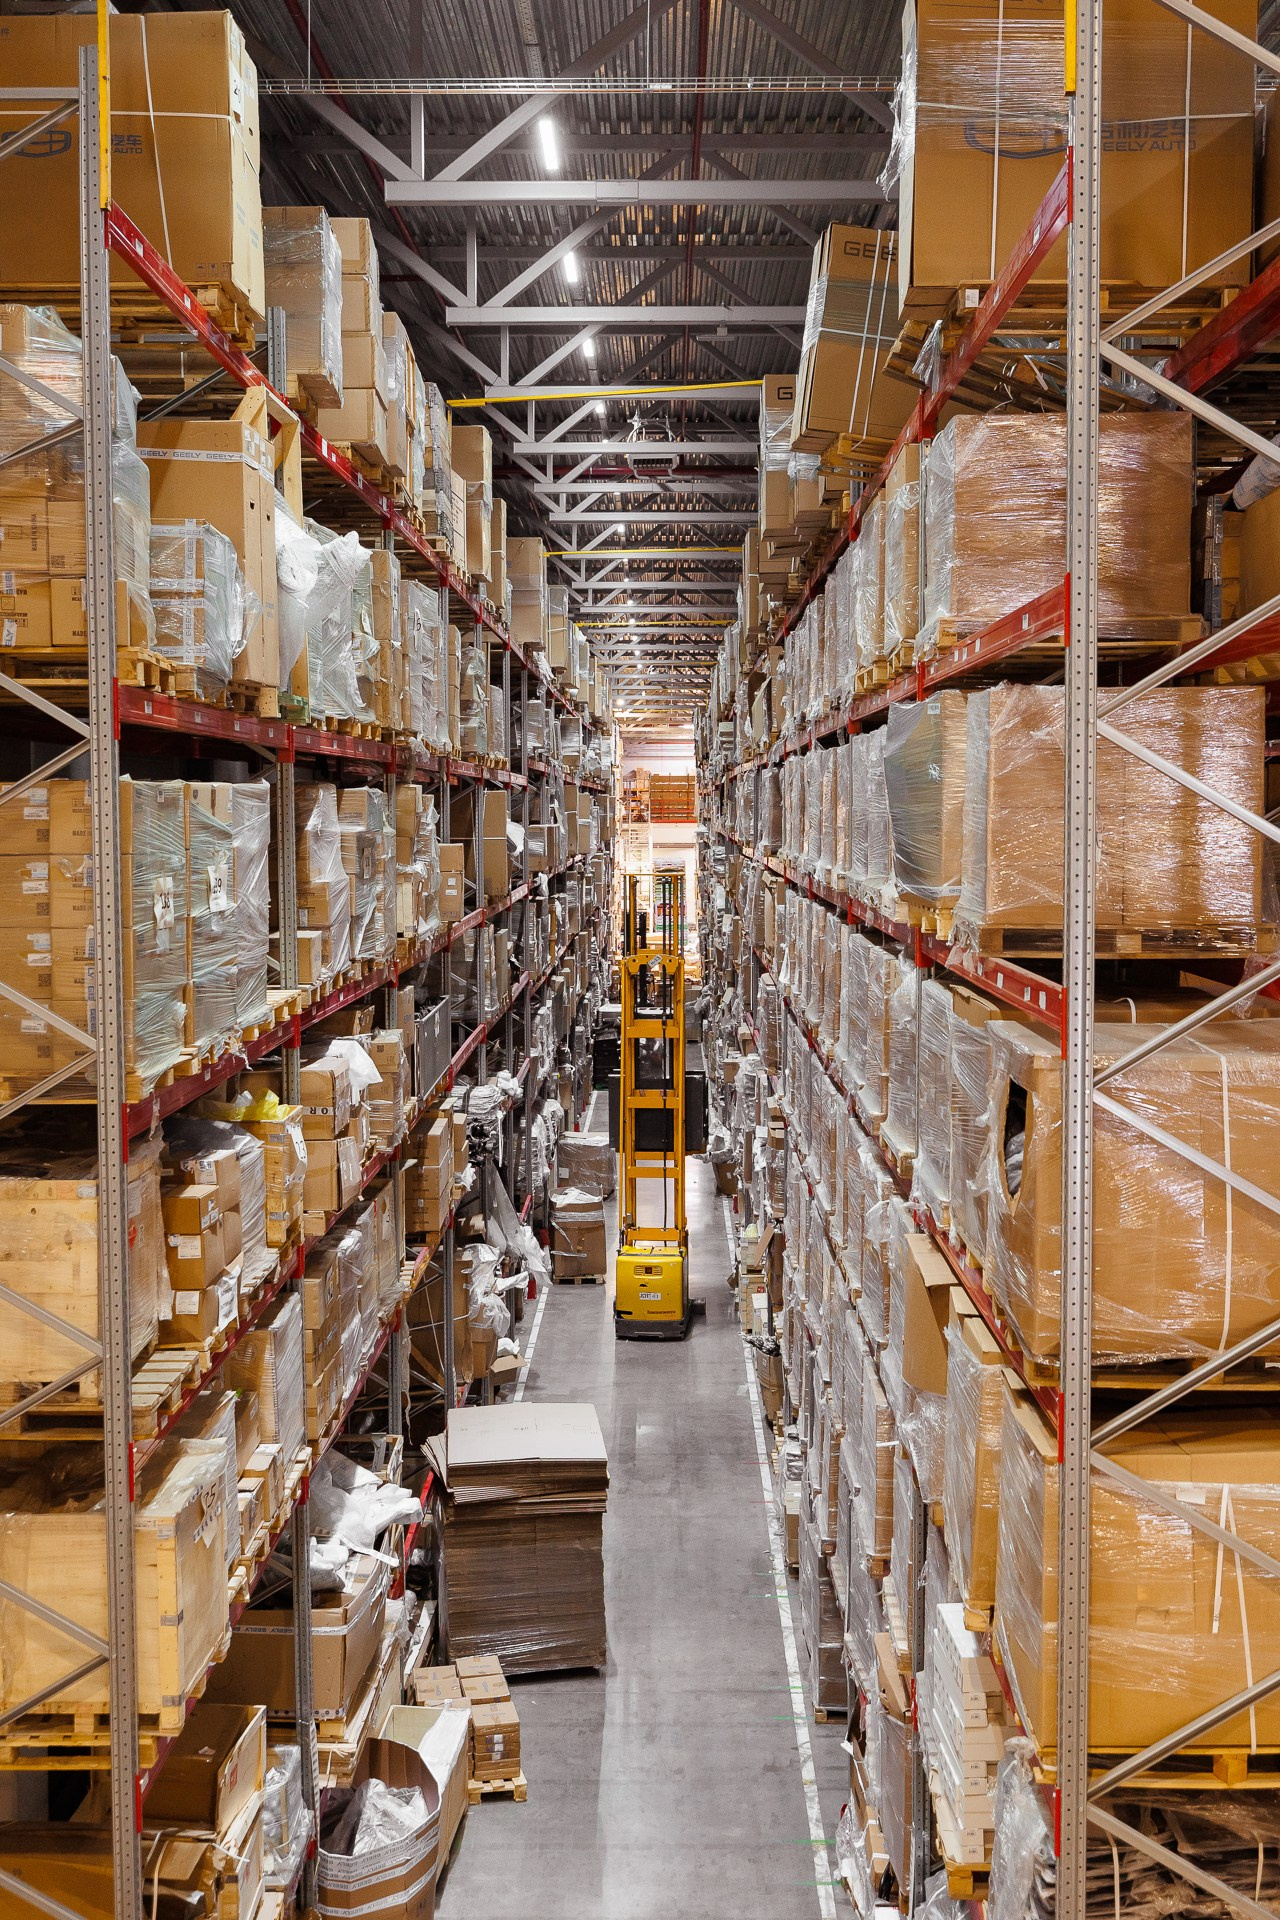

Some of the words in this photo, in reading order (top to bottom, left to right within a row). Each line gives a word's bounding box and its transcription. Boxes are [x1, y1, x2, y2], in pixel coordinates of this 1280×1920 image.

[113, 146, 144, 154] AUTO
[1101, 140, 1146, 152] EELY
[1149, 140, 1197, 152] AUTO
[844, 240, 897, 262] GEE
[777, 386, 794, 400] G
[140, 449, 168, 457] GEELY
[172, 451, 201, 459] GEELY
[326, 1882, 349, 1890] GEELY
[352, 1878, 373, 1889] GEELY
